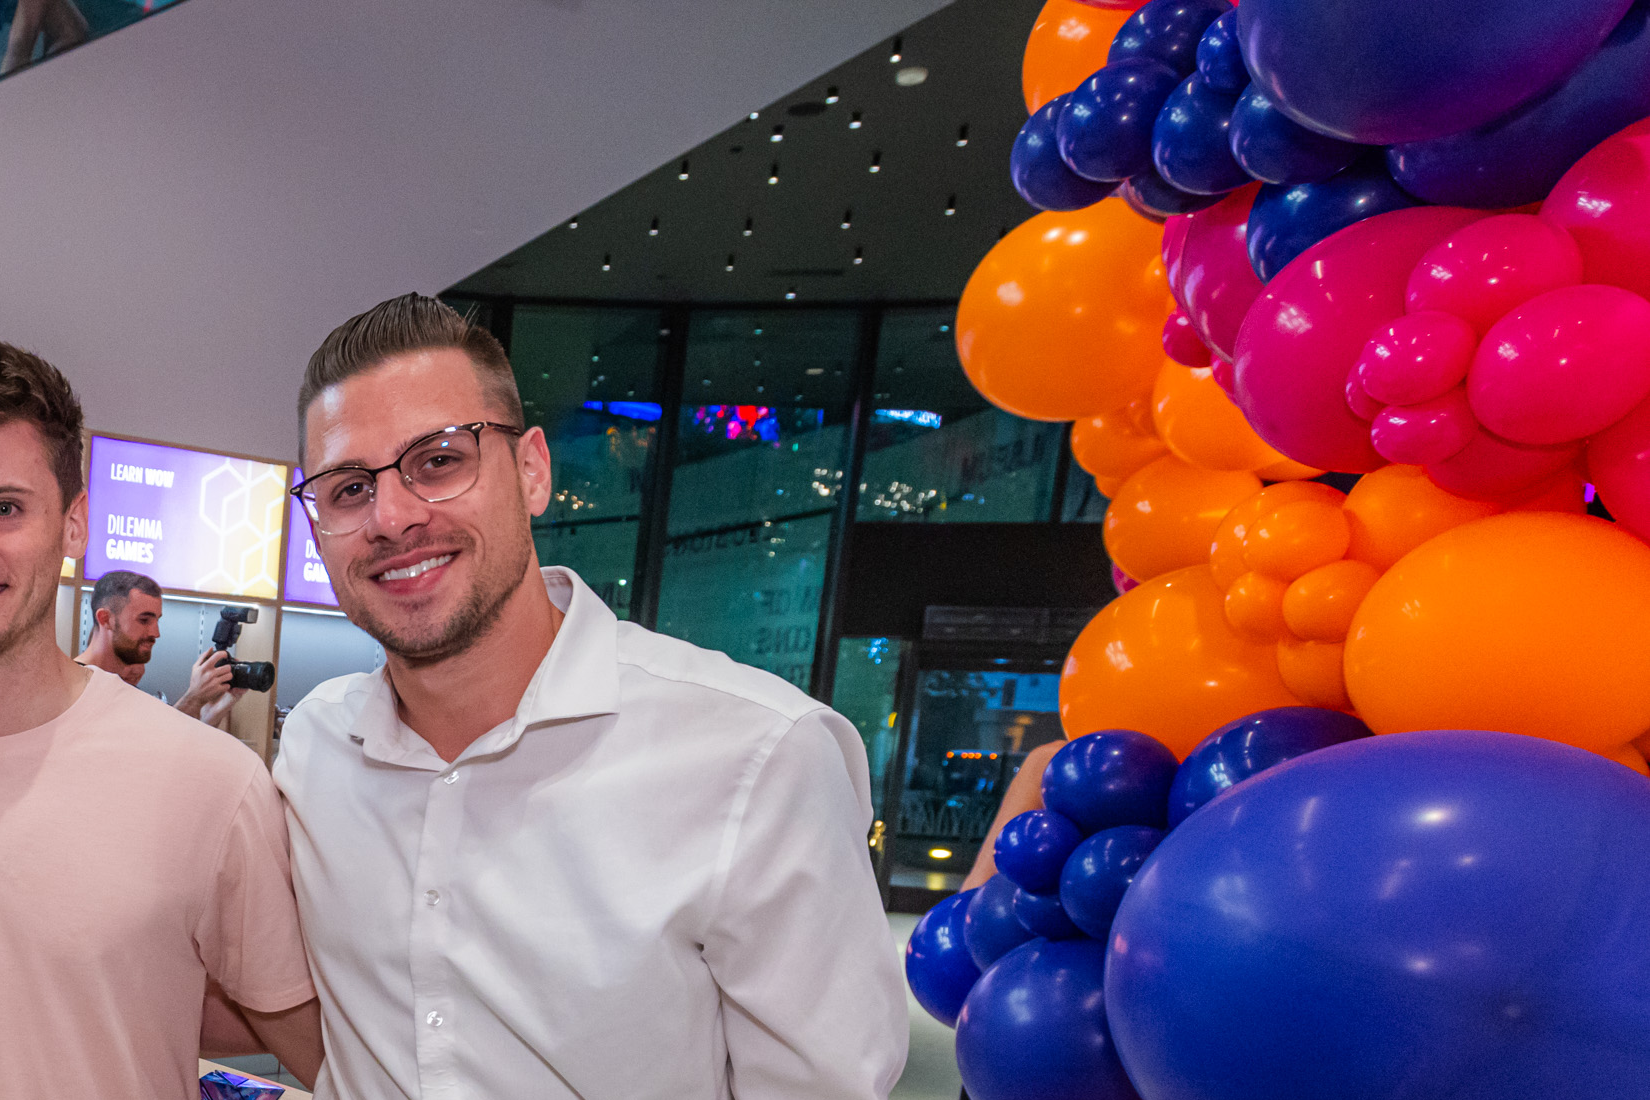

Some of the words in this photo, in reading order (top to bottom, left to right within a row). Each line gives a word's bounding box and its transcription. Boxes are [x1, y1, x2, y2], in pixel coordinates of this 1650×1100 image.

[110, 462, 144, 484] LEARN
[145, 467, 175, 488] WOW
[107, 513, 163, 541] DILEMMA
[105, 538, 155, 564] GAMES
